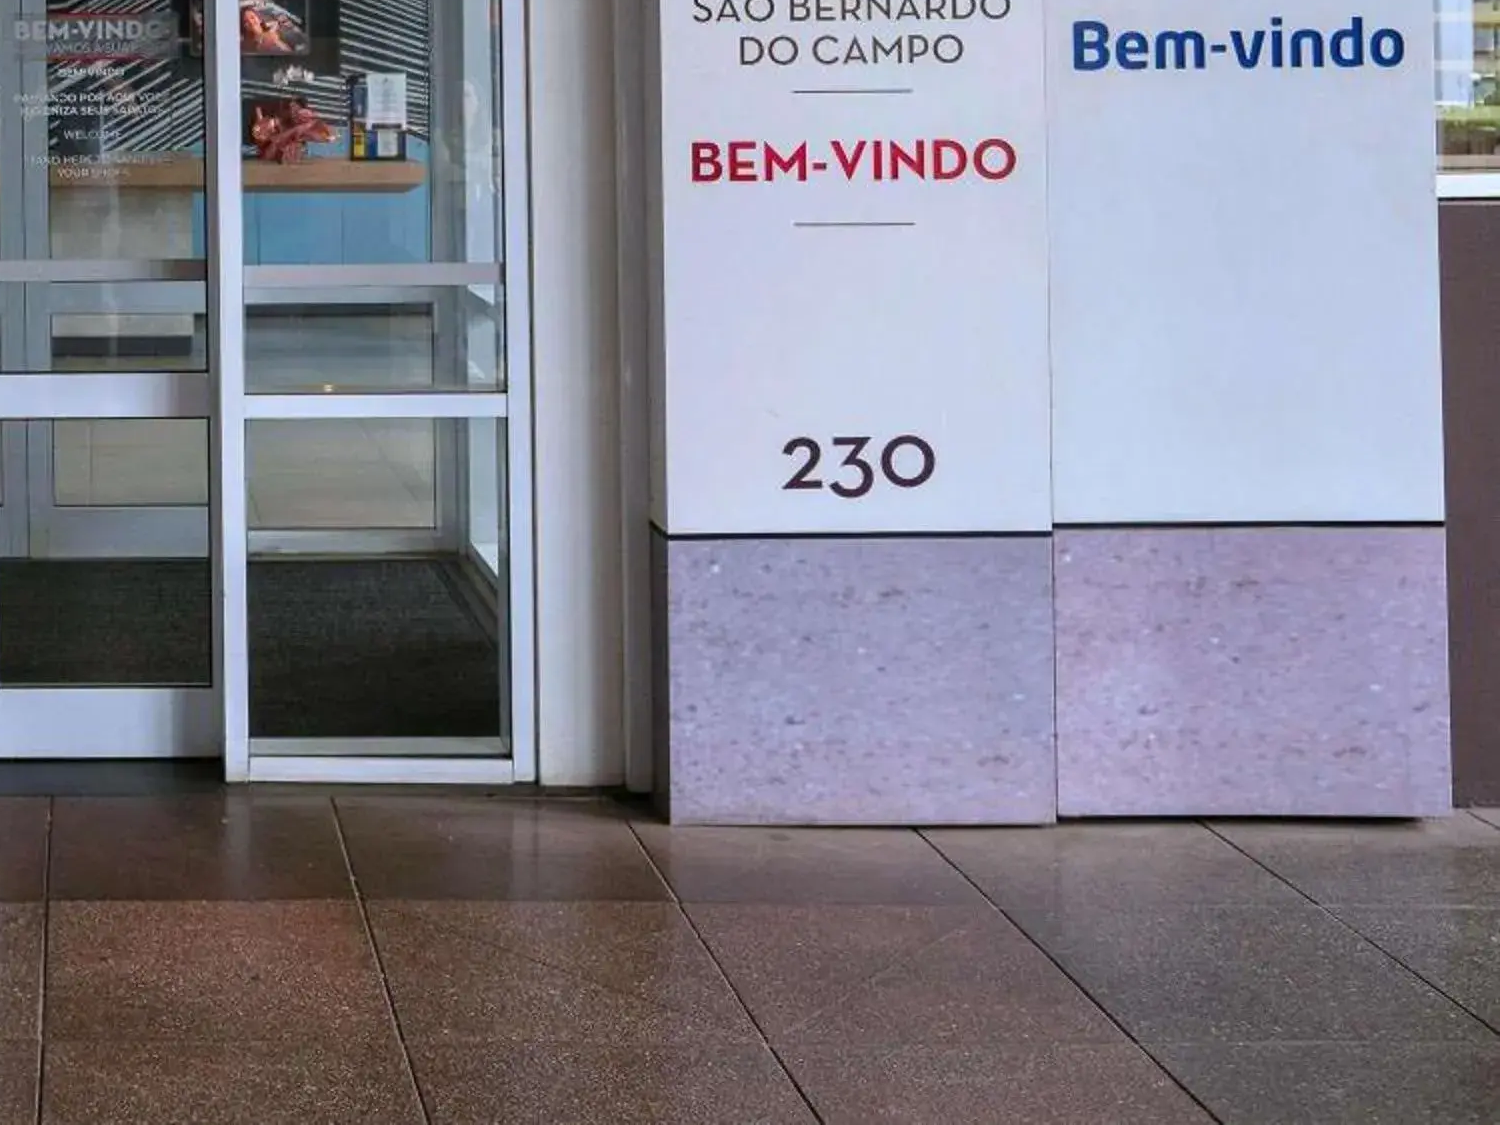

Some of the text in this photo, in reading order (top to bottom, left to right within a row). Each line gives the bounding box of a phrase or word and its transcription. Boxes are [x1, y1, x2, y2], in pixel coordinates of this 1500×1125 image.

[739, 33, 964, 66] DO CAMPO
[1073, 17, 1405, 71] Bem-vindo
[691, 138, 1017, 183] BEM-VINDO
[782, 434, 936, 499] 230
